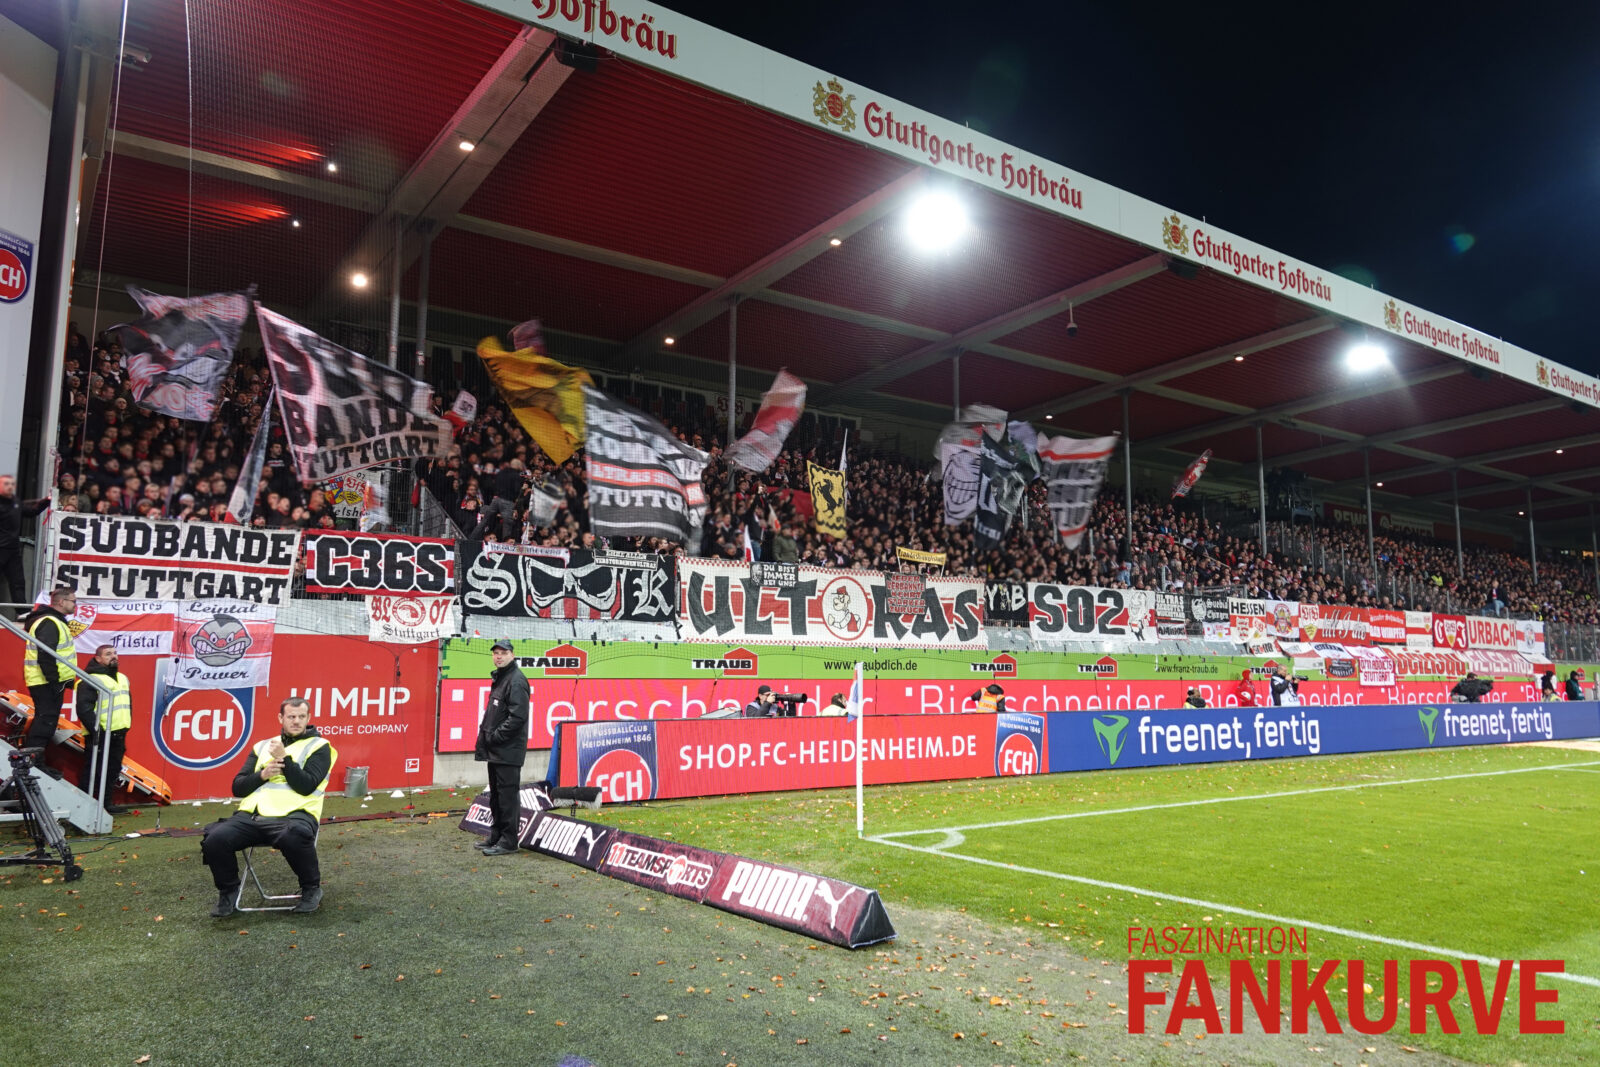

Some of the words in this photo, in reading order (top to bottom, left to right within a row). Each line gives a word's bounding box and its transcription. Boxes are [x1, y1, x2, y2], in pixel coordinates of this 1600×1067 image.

[1001, 152, 1083, 210] Hofbräu
[0, 264, 21, 289] CH
[1279, 261, 1332, 302] Hofbräu
[1462, 332, 1500, 364] Hofbräu
[59, 516, 295, 566] SÜDBANDE
[314, 535, 448, 594] C36S
[763, 571, 796, 580] IMMER
[778, 565, 796, 573] BIST
[56, 565, 289, 606] STUTTGART
[187, 601, 258, 614] Leintal
[1231, 602, 1265, 615] HESSEN
[110, 635, 161, 648] Filstal
[382, 624, 440, 641] Stuttgart
[1468, 619, 1517, 647] URBACH
[184, 667, 250, 680] Power
[694, 659, 752, 669] TRAUB
[824, 659, 918, 671] www.aubdich.de
[972, 662, 1014, 672] TRAUB
[1079, 664, 1114, 673] TRAUB
[330, 687, 411, 717] MHP
[920, 685, 1164, 713] Bieschneider
[173, 709, 234, 741] FCH
[316, 725, 354, 735] RSCHE
[357, 724, 409, 734] COMPANY
[1138, 715, 1252, 759] freenet,
[1253, 712, 1321, 755] fertig
[1443, 707, 1511, 742] freenet,
[1511, 706, 1553, 740] fertig
[633, 733, 652, 744] 1846
[679, 734, 977, 771] SHOP.FC-HEIDENHEIM.DE
[1004, 749, 1033, 775] FCH
[530, 816, 587, 857] PUMA
[721, 861, 820, 922] PUMA
